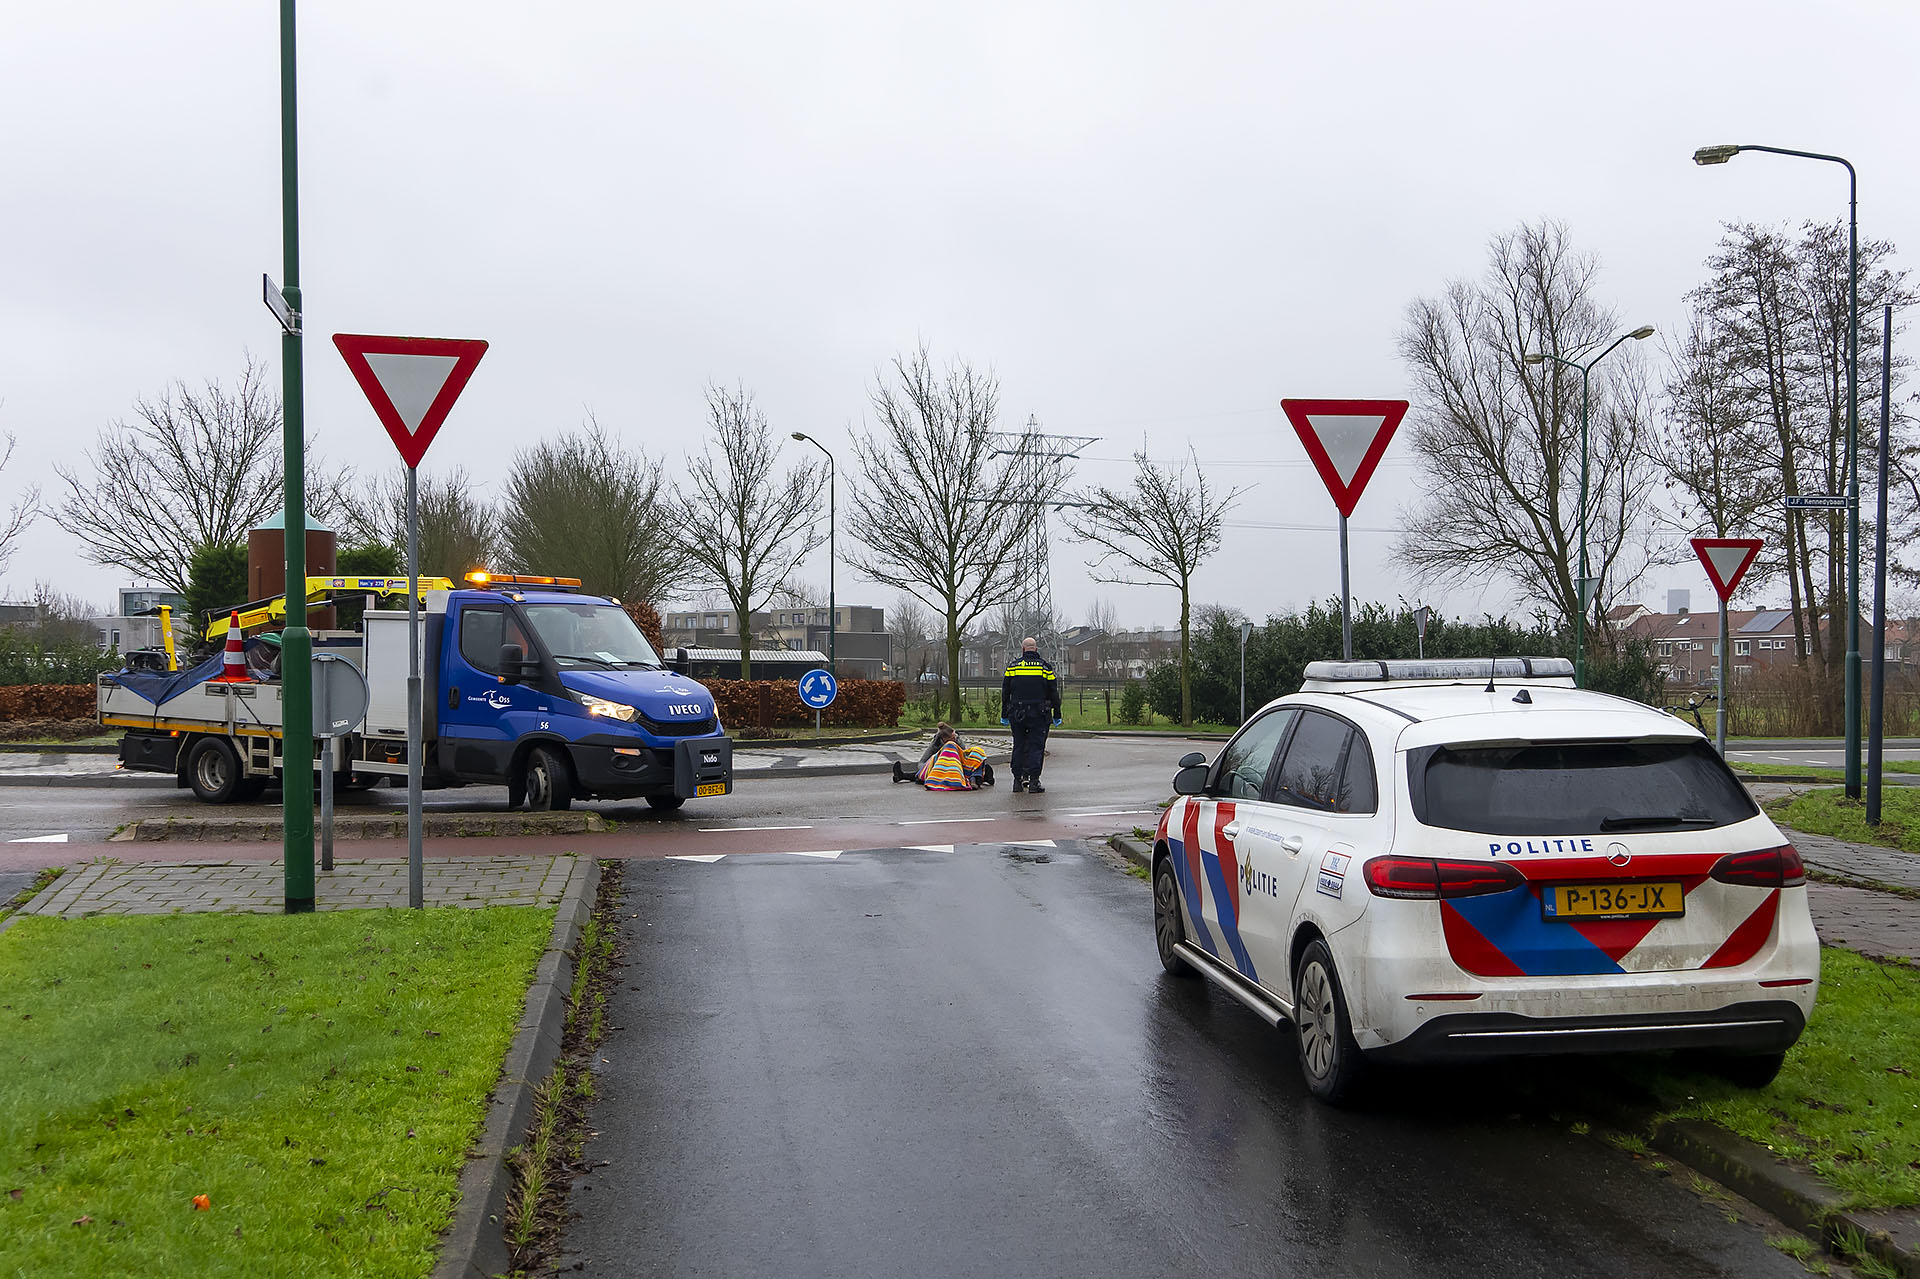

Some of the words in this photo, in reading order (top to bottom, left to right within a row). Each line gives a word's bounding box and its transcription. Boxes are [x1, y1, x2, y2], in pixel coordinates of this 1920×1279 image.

[668, 704, 701, 716] IVECO
[540, 721, 549, 730] 56
[703, 754, 718, 763] Nido
[1489, 839, 1594, 857] POLITIE
[1240, 864, 1277, 898] POLITIE
[1566, 887, 1666, 912] P-136-JX
[1545, 904, 1555, 912] NL
